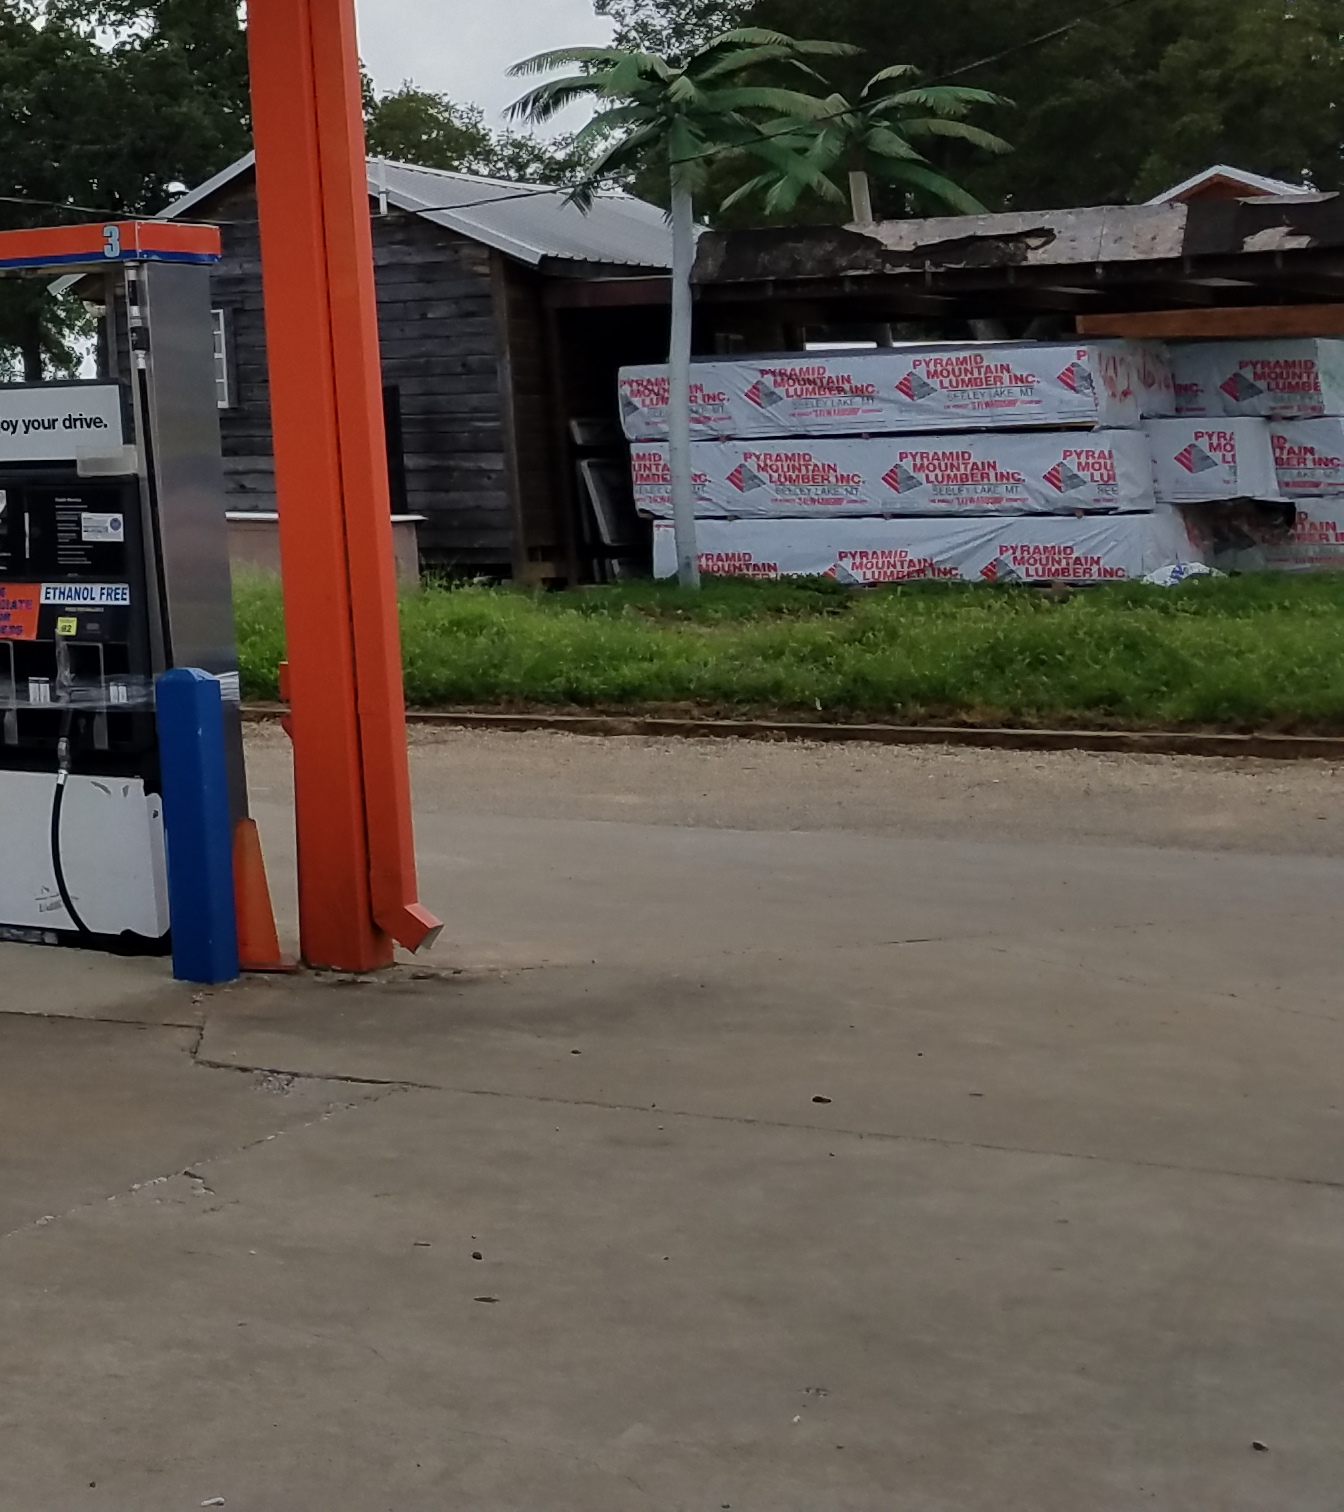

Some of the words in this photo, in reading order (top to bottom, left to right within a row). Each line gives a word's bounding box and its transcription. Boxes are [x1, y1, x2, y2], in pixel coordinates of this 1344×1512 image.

[103, 225, 120, 258] 3
[913, 353, 984, 370] PYRAMID
[759, 366, 826, 378] PYRAMID
[926, 363, 1011, 379] MOUNTAIN
[773, 374, 852, 388] MOUNTAIN
[939, 375, 1004, 390] LUMBER
[1008, 373, 1041, 385] INC.
[785, 386, 846, 399] LUMBER
[22, 417, 58, 434] your
[63, 413, 108, 430] drive.
[743, 452, 812, 463] PYRAMID
[899, 451, 972, 462] PYRAMID
[757, 463, 838, 473] MOUNTAIN
[913, 461, 997, 472] MOUNTAIN
[769, 474, 830, 484] LUMBER
[835, 474, 865, 484] INC.
[925, 472, 990, 484] LUMBER
[995, 471, 1026, 483] INC.
[838, 550, 908, 561] PYRAMID
[999, 545, 1074, 556] PYRAMID
[852, 557, 934, 571] MOUNTAIN
[1012, 556, 1100, 567] MOUNTAIN
[863, 569, 926, 581] LUMBER
[1025, 567, 1092, 578] LUMBER
[45, 586, 95, 601] ETHANOL
[99, 586, 128, 602] FREE
